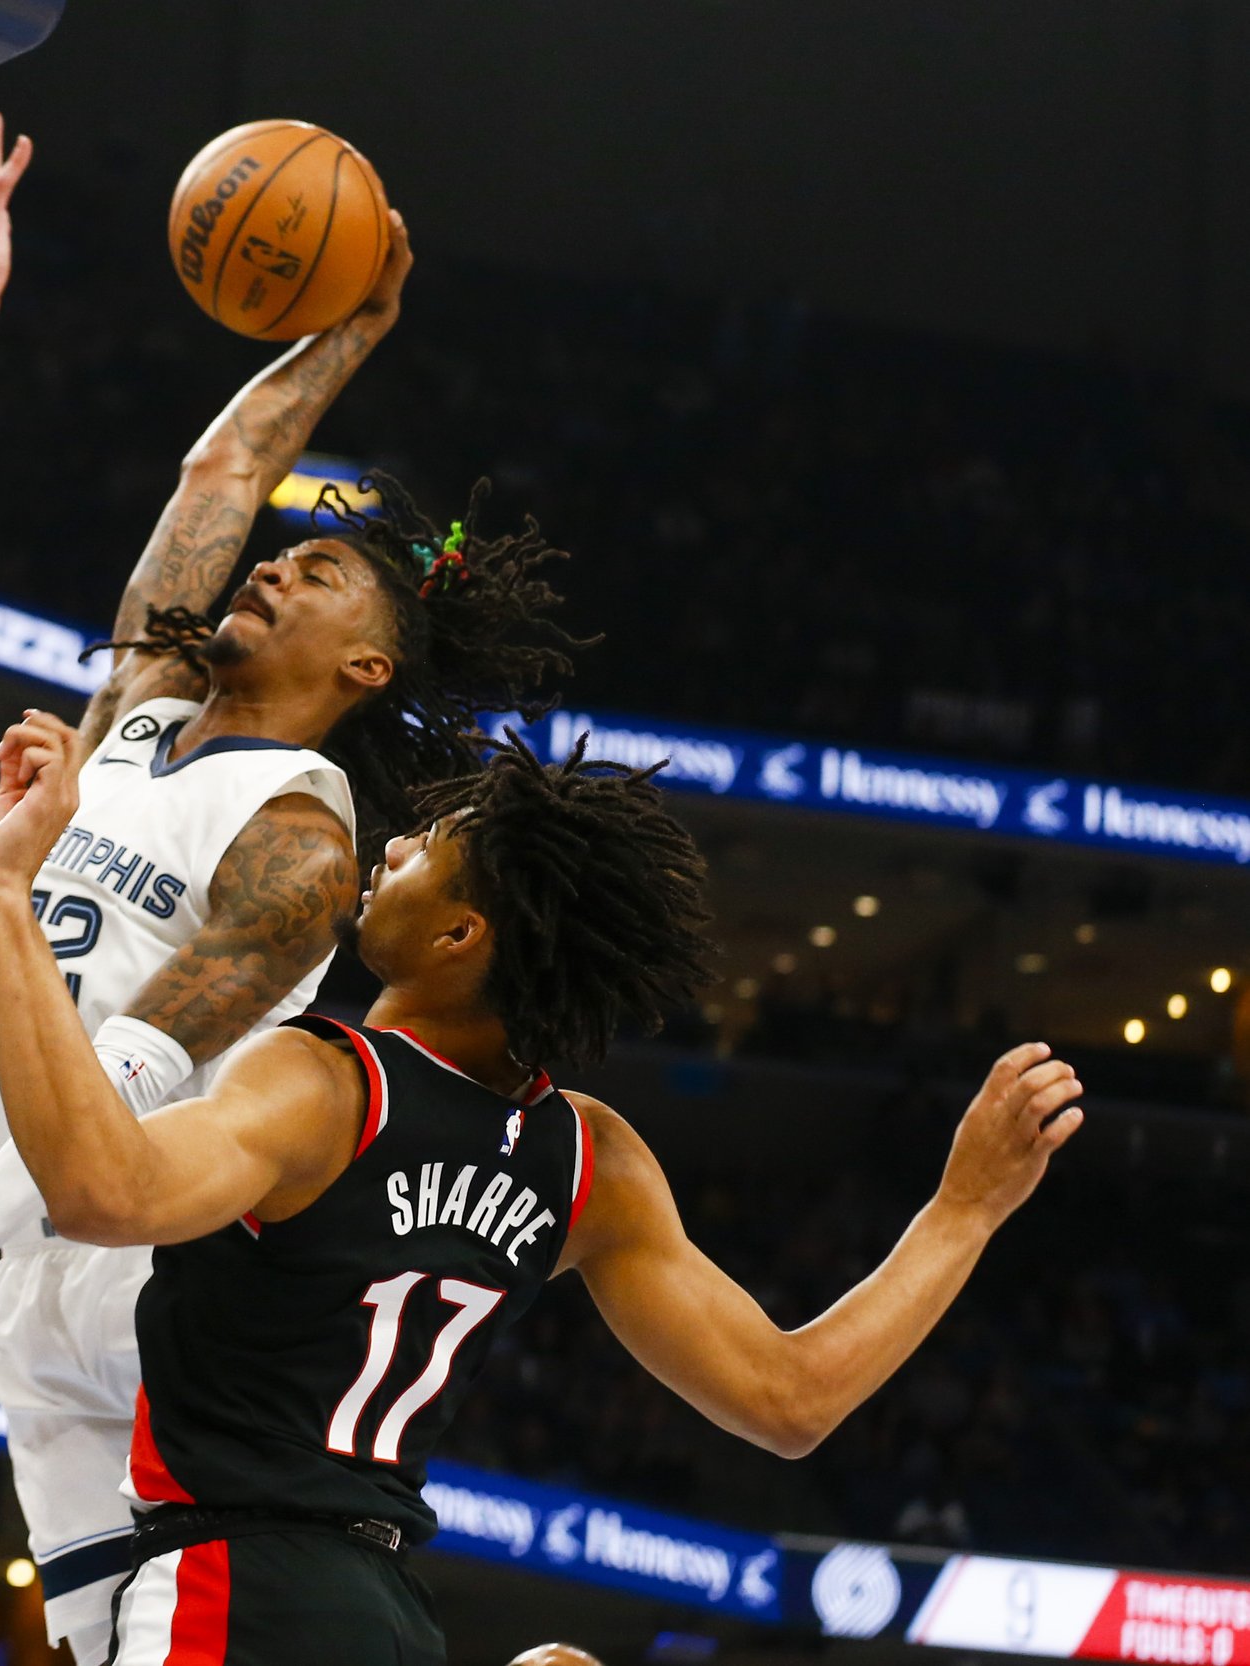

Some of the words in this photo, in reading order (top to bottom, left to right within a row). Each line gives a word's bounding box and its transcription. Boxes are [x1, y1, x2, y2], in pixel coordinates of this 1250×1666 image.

[820, 747, 1008, 829] Hennessy
[46, 826, 187, 919] MPHIS
[386, 1162, 556, 1267] SHARPE
[326, 1269, 508, 1464] 17
[584, 1507, 738, 1602] Hennessy
[1005, 1567, 1037, 1648] 9
